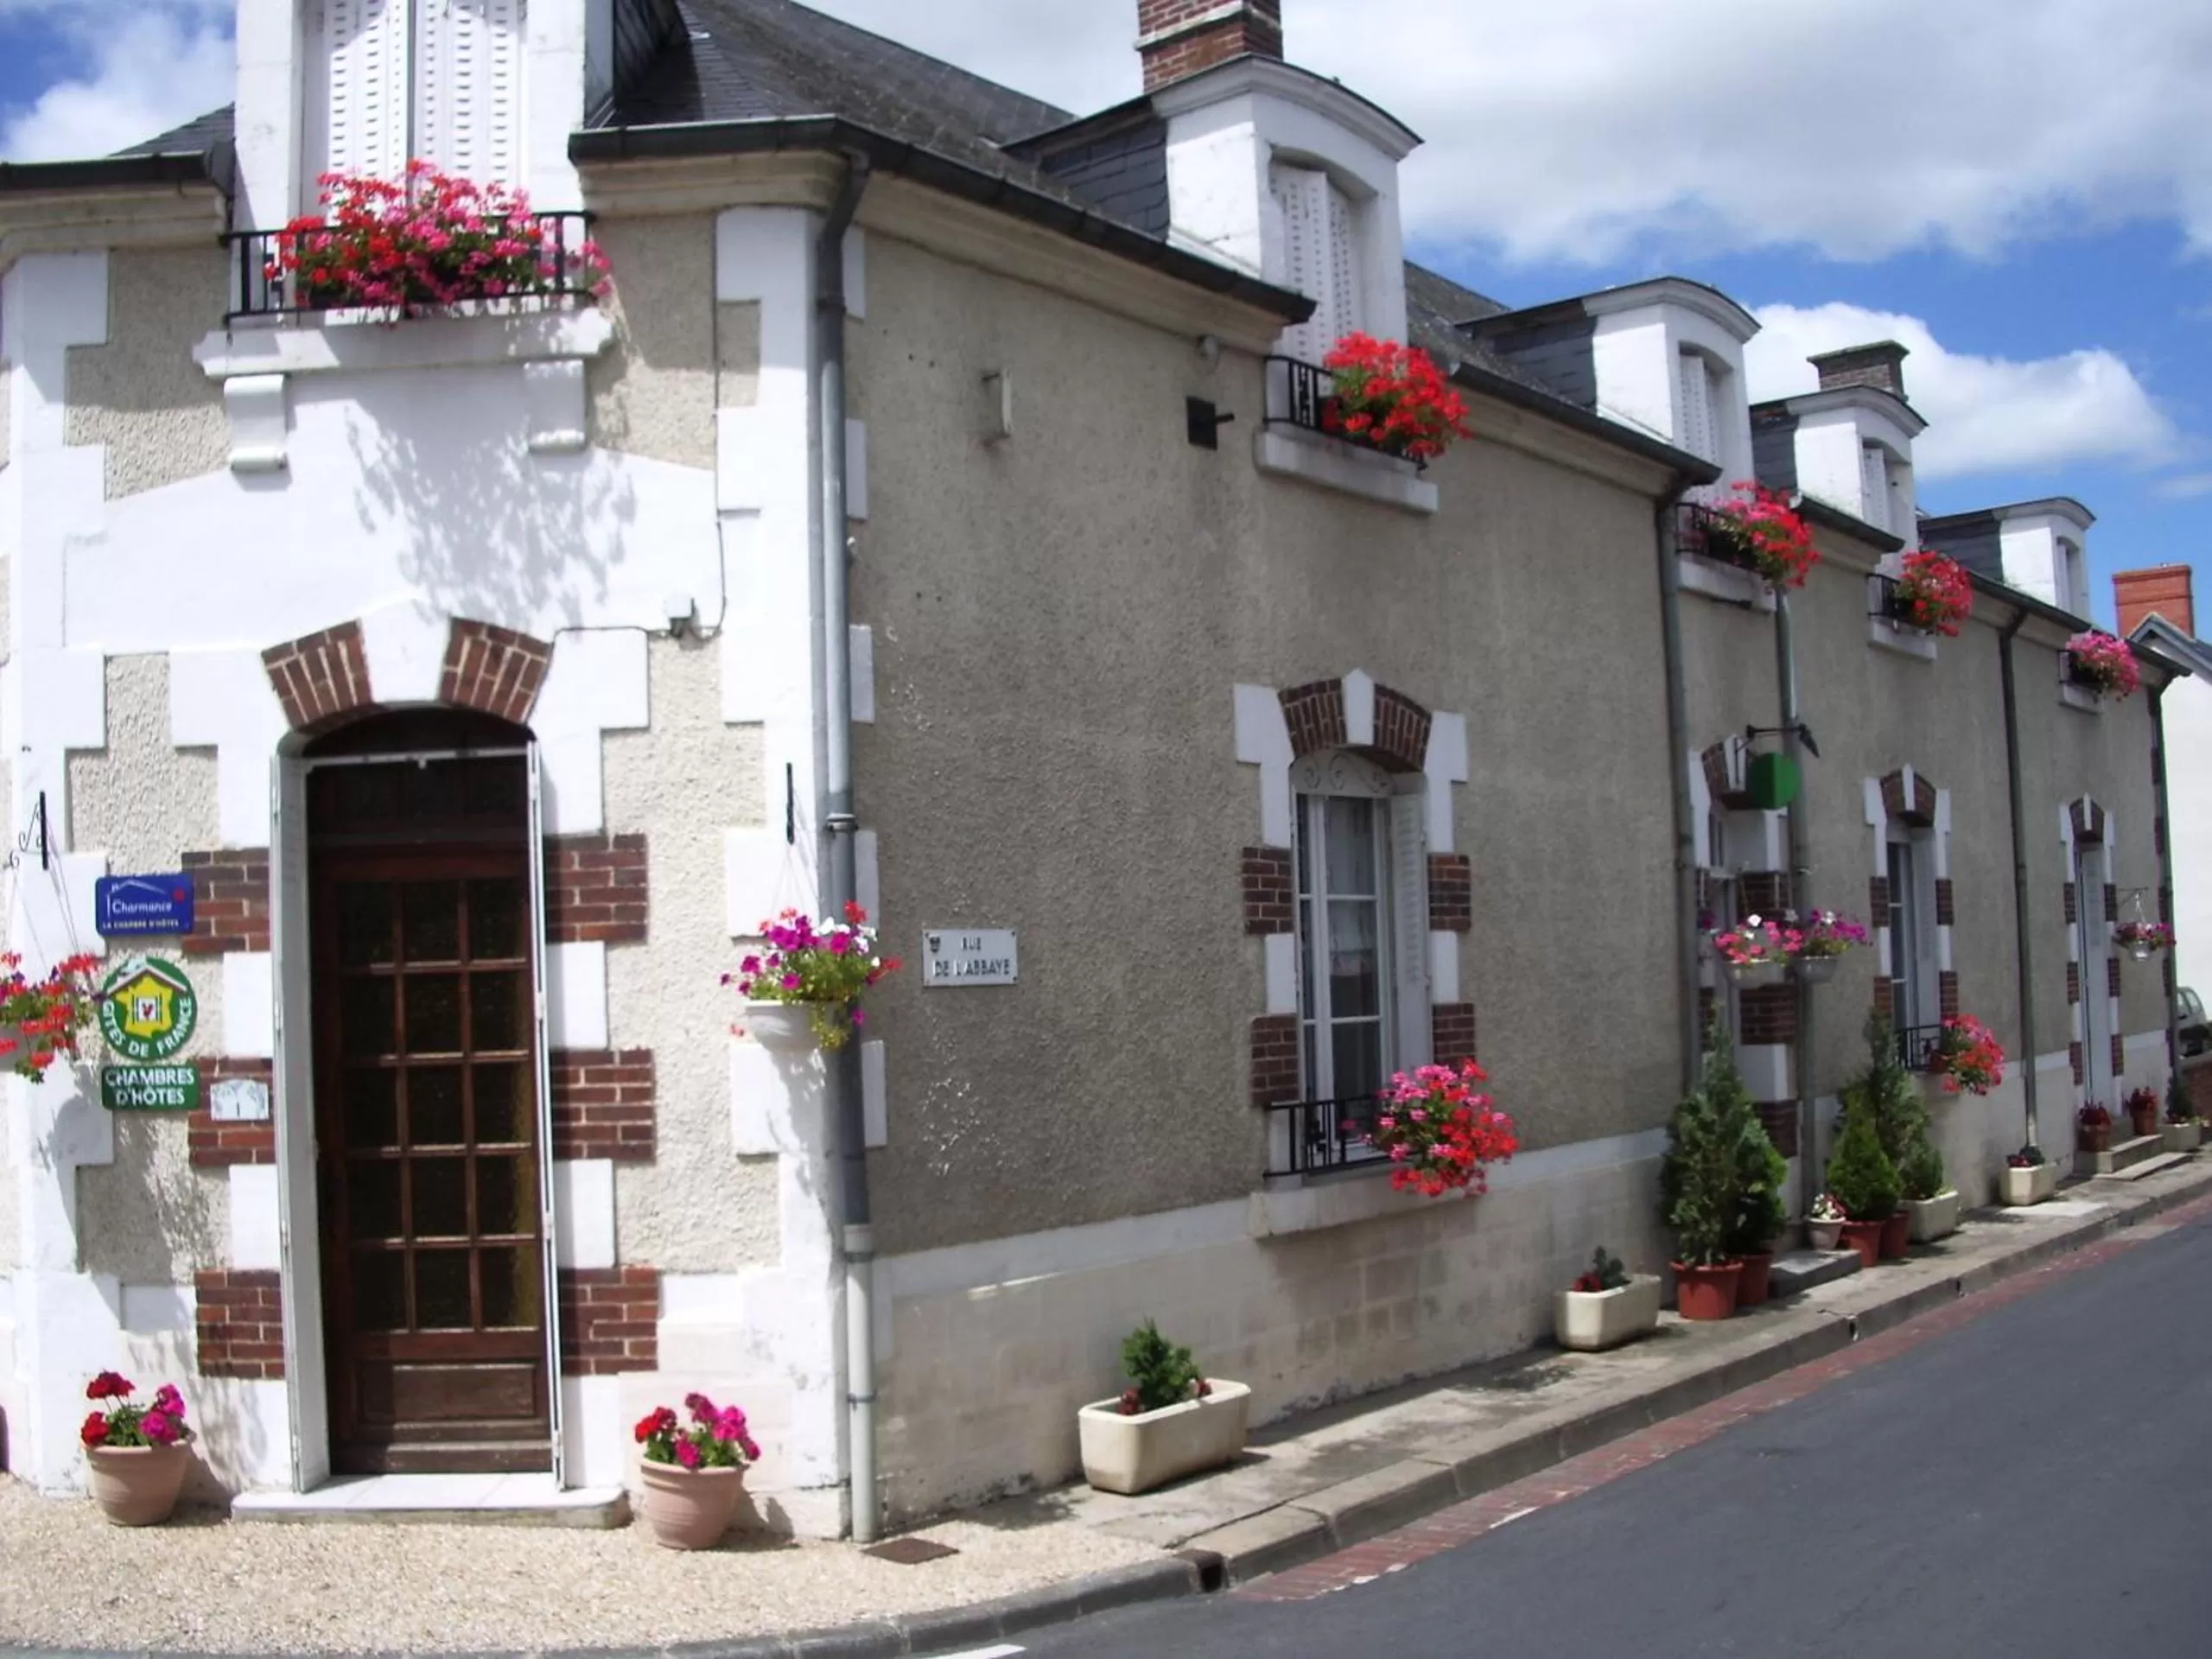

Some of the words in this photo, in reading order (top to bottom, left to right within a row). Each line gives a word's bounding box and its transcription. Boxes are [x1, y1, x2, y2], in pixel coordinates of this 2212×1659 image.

[111, 899, 172, 914] Charmance
[961, 937, 982, 951] RUE
[933, 960, 950, 977] DE
[128, 1040, 149, 1058] DE
[156, 996, 193, 1055] FRANCE
[105, 1068, 194, 1087] CHAMBRES
[116, 1085, 185, 1105] D'HÔTES
